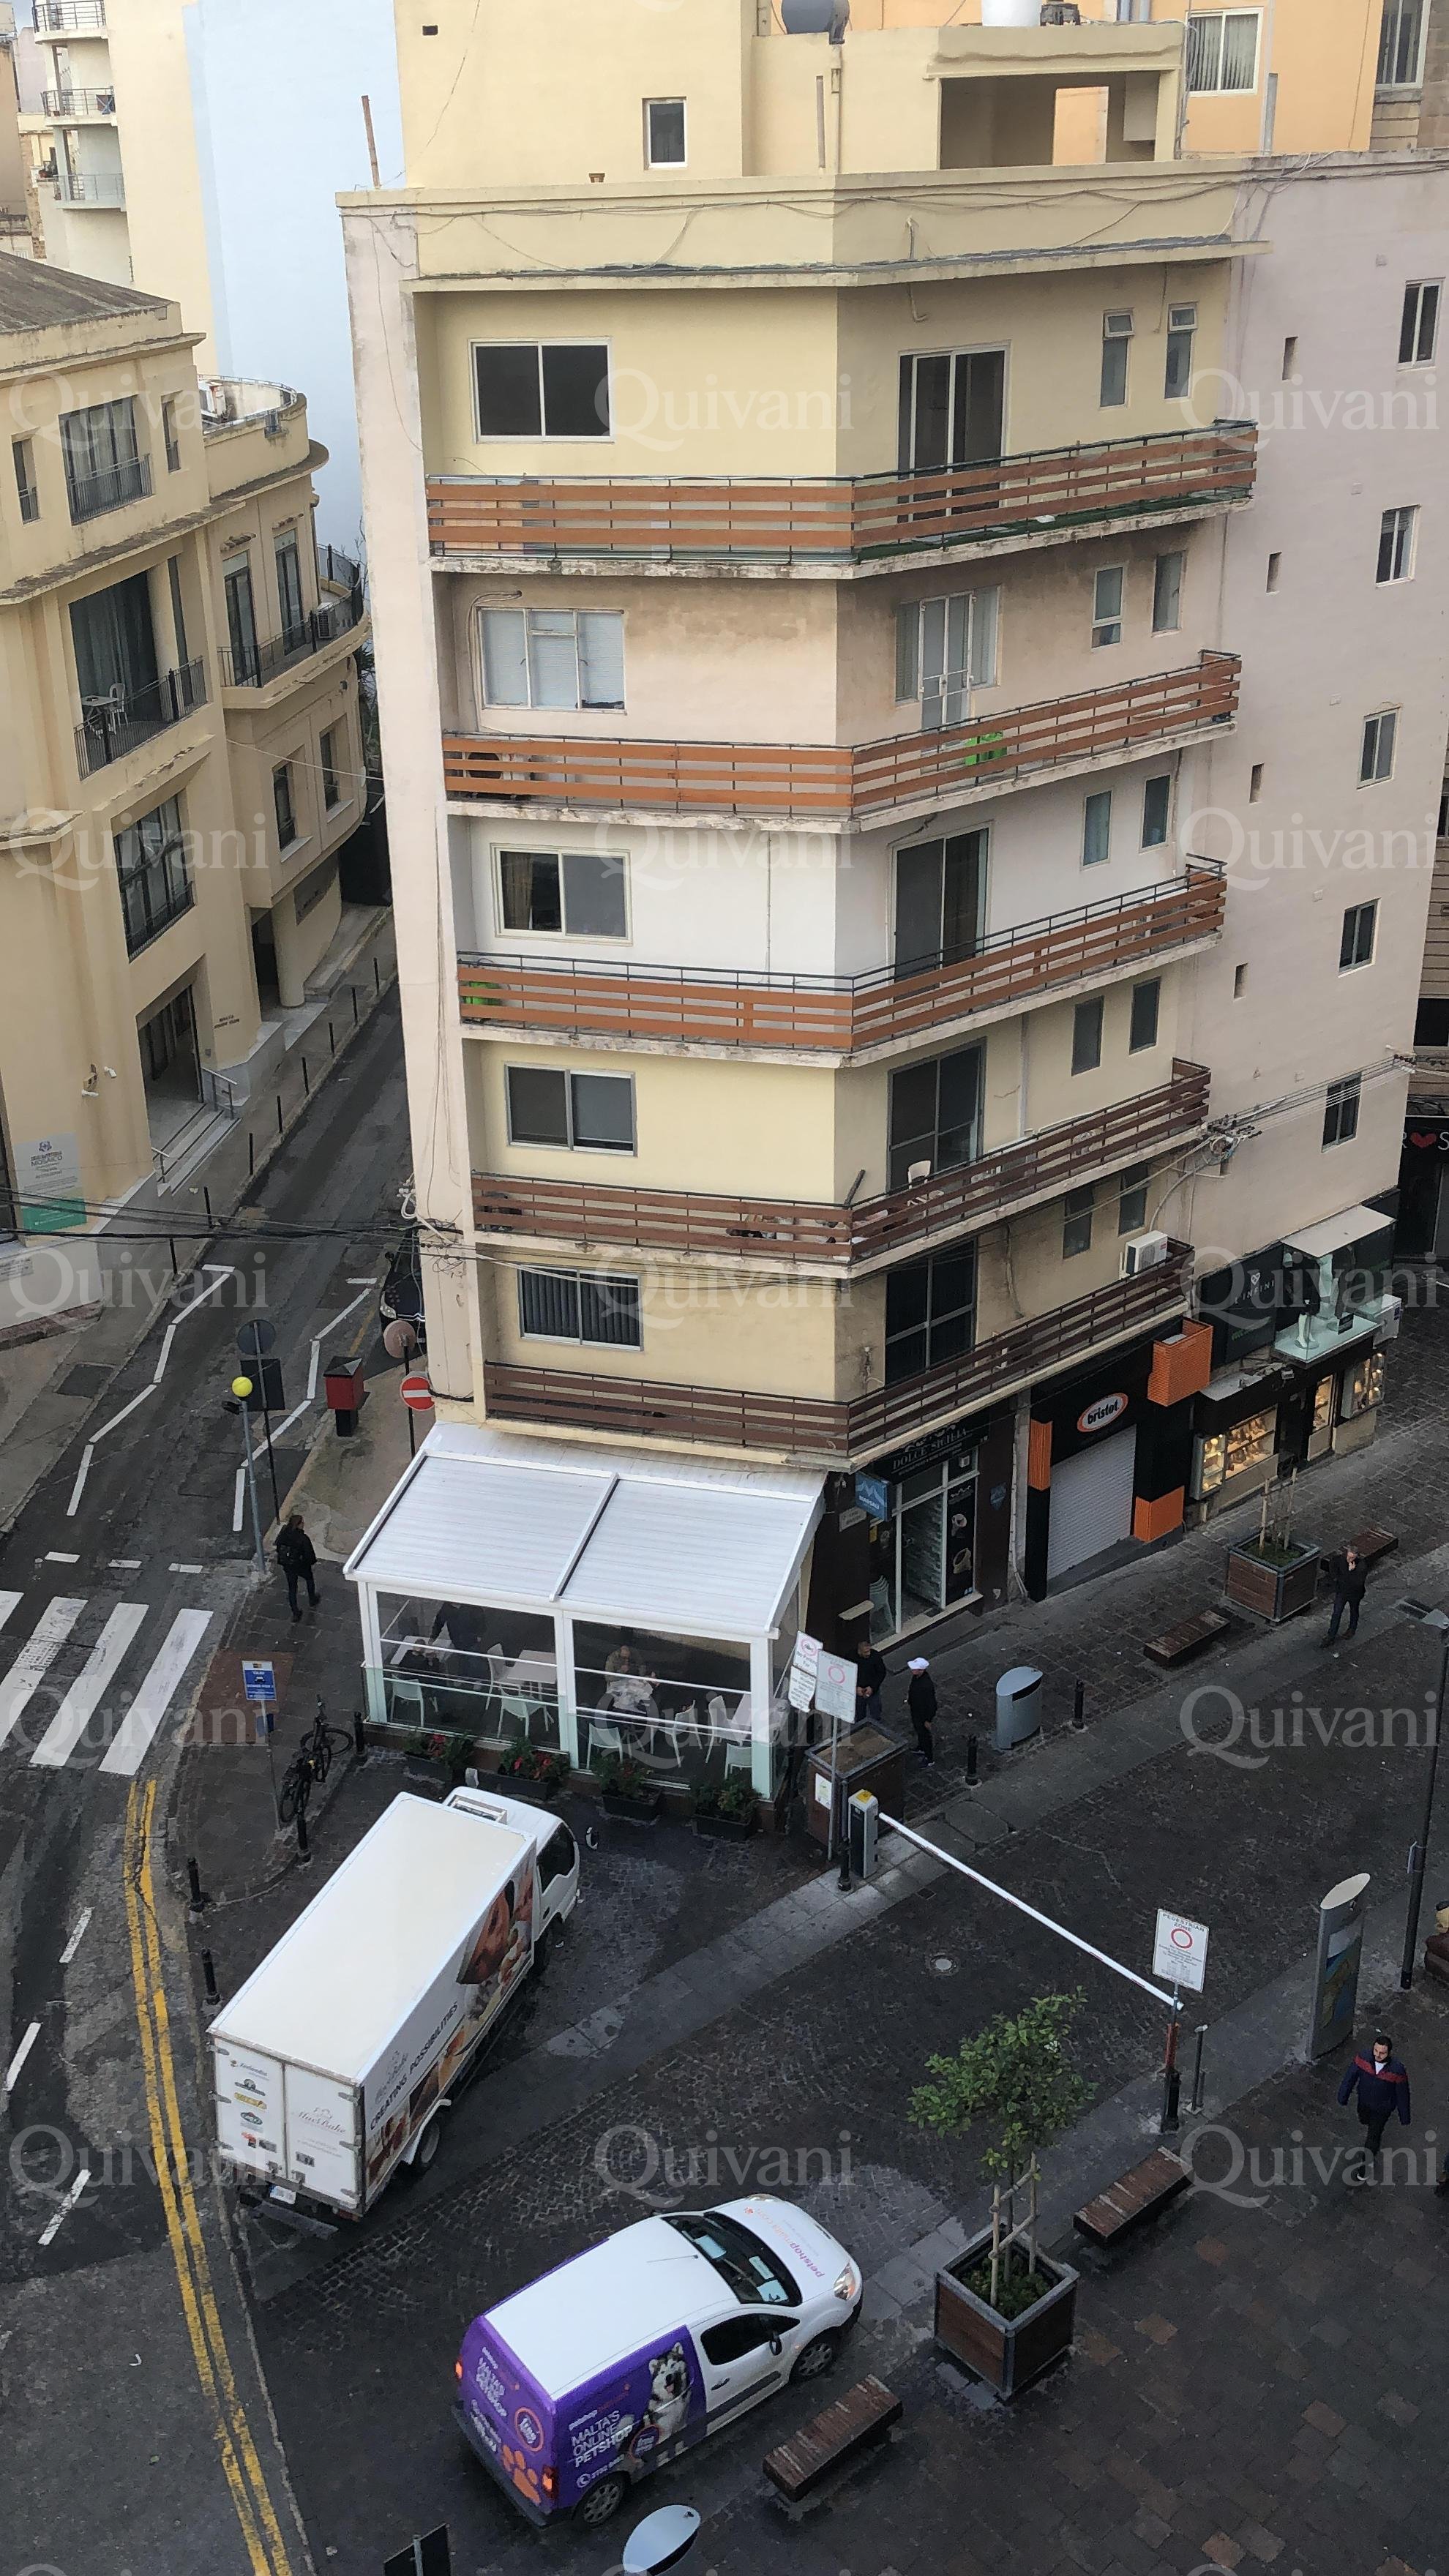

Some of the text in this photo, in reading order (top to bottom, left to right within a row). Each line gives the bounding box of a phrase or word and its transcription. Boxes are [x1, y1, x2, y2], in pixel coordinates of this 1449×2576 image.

[1162, 1912, 1205, 1933] PEDESTRIAN
[370, 2073, 408, 2131] CREATING
[408, 2002, 458, 2075] POSSIBILITIES
[571, 2410, 620, 2446] MALTA'S
[572, 2423, 618, 2457] ONLINE
[574, 2425, 633, 2468] PETSHOP
